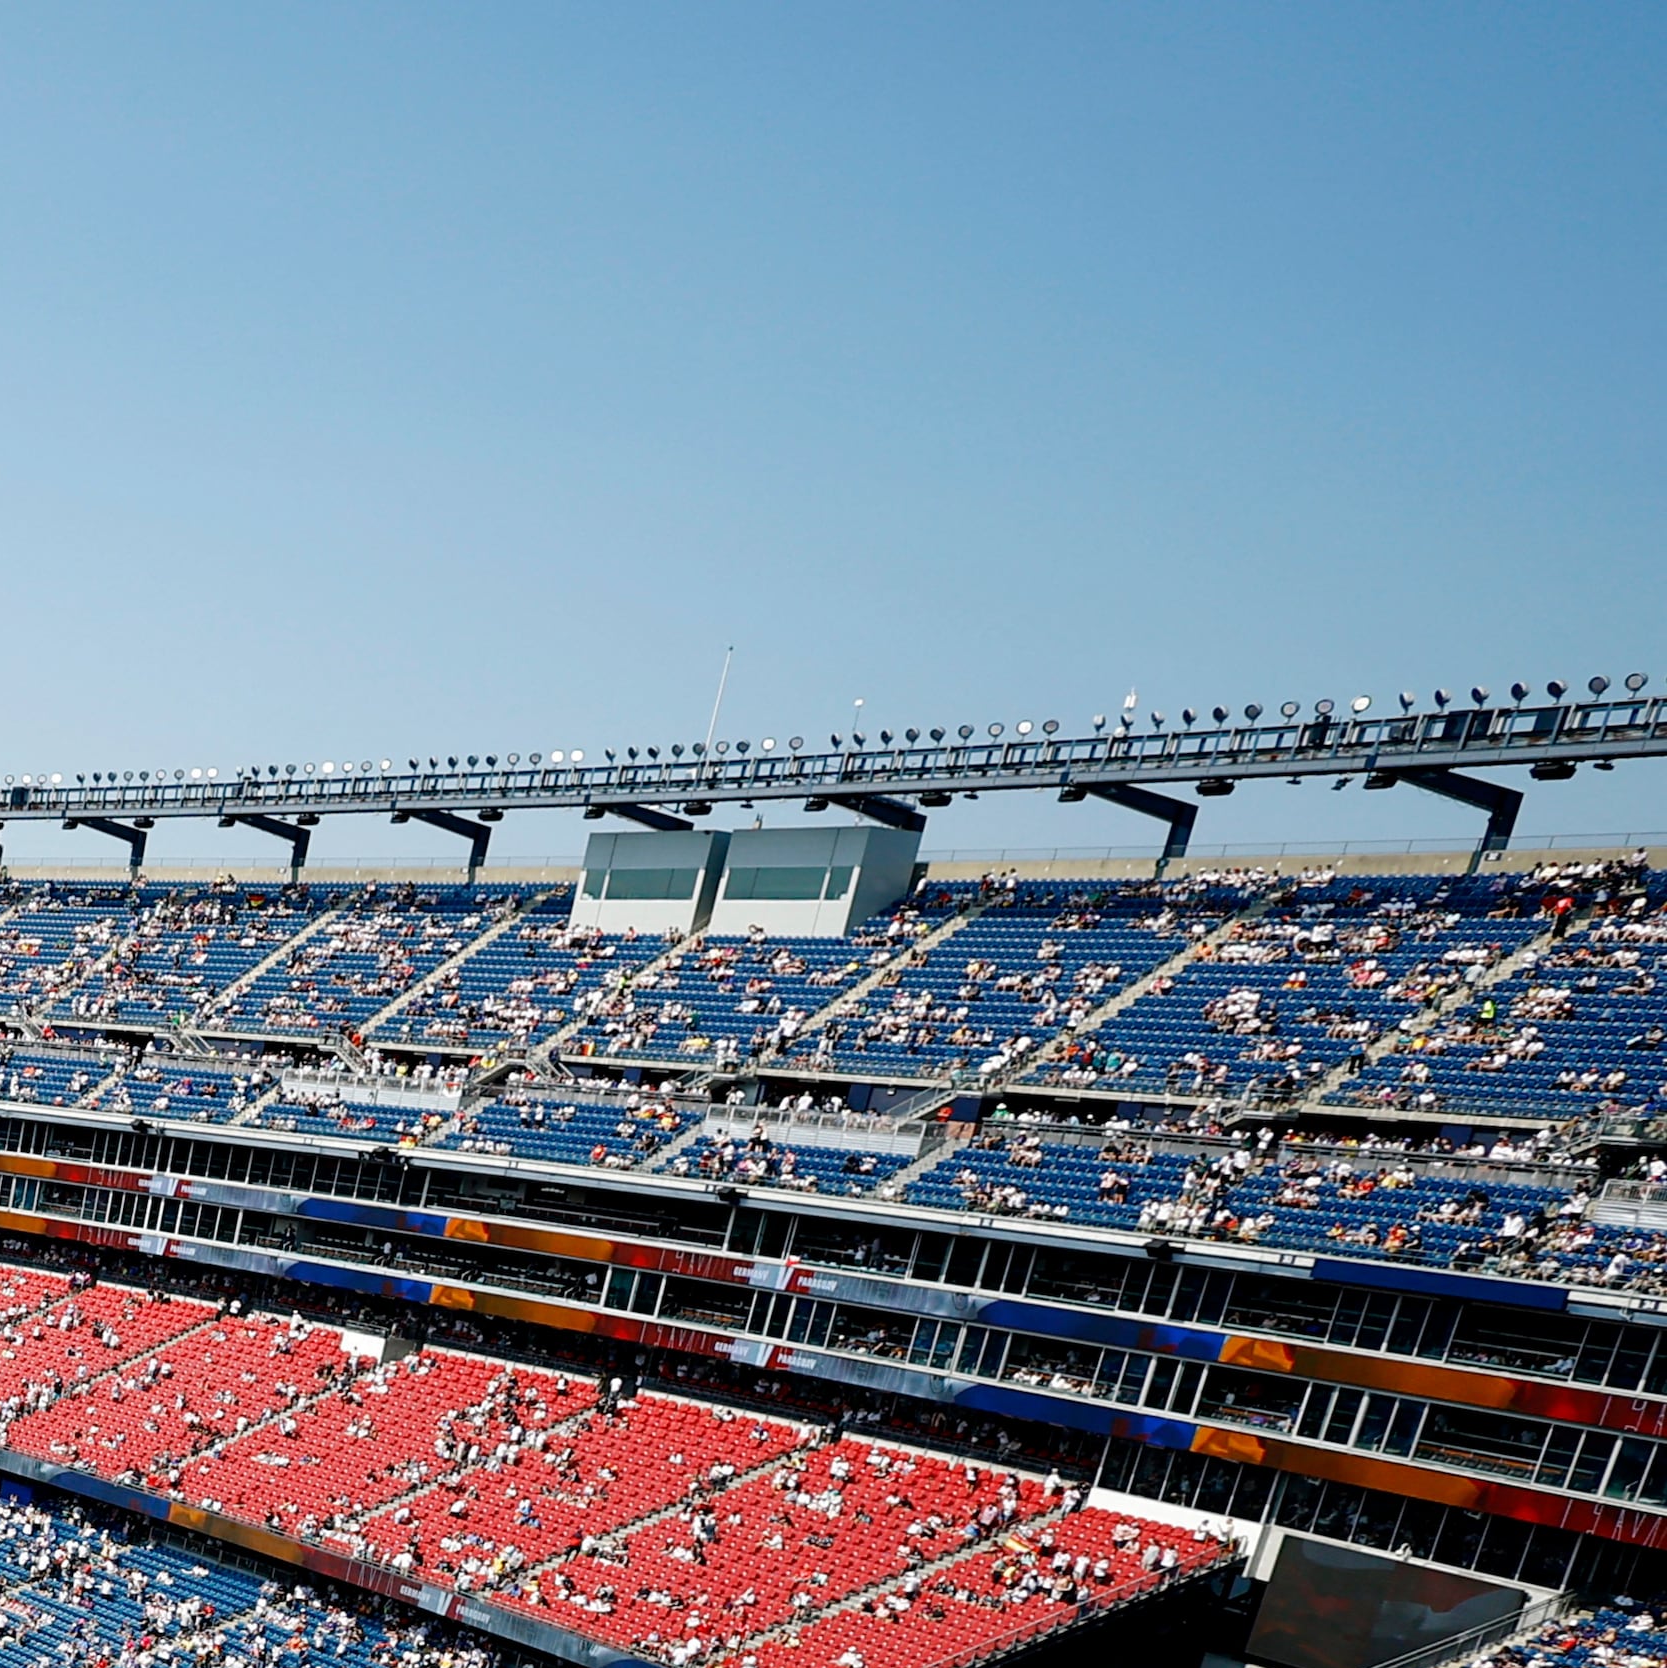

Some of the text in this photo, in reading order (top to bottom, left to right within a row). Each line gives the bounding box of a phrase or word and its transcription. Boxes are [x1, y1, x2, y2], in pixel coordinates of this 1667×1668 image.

[733, 1265, 769, 1281] GERMANY
[797, 1276, 837, 1292] PARAGUAY
[714, 1341, 749, 1356] GERMANY
[777, 1353, 817, 1370] PARAGUAY
